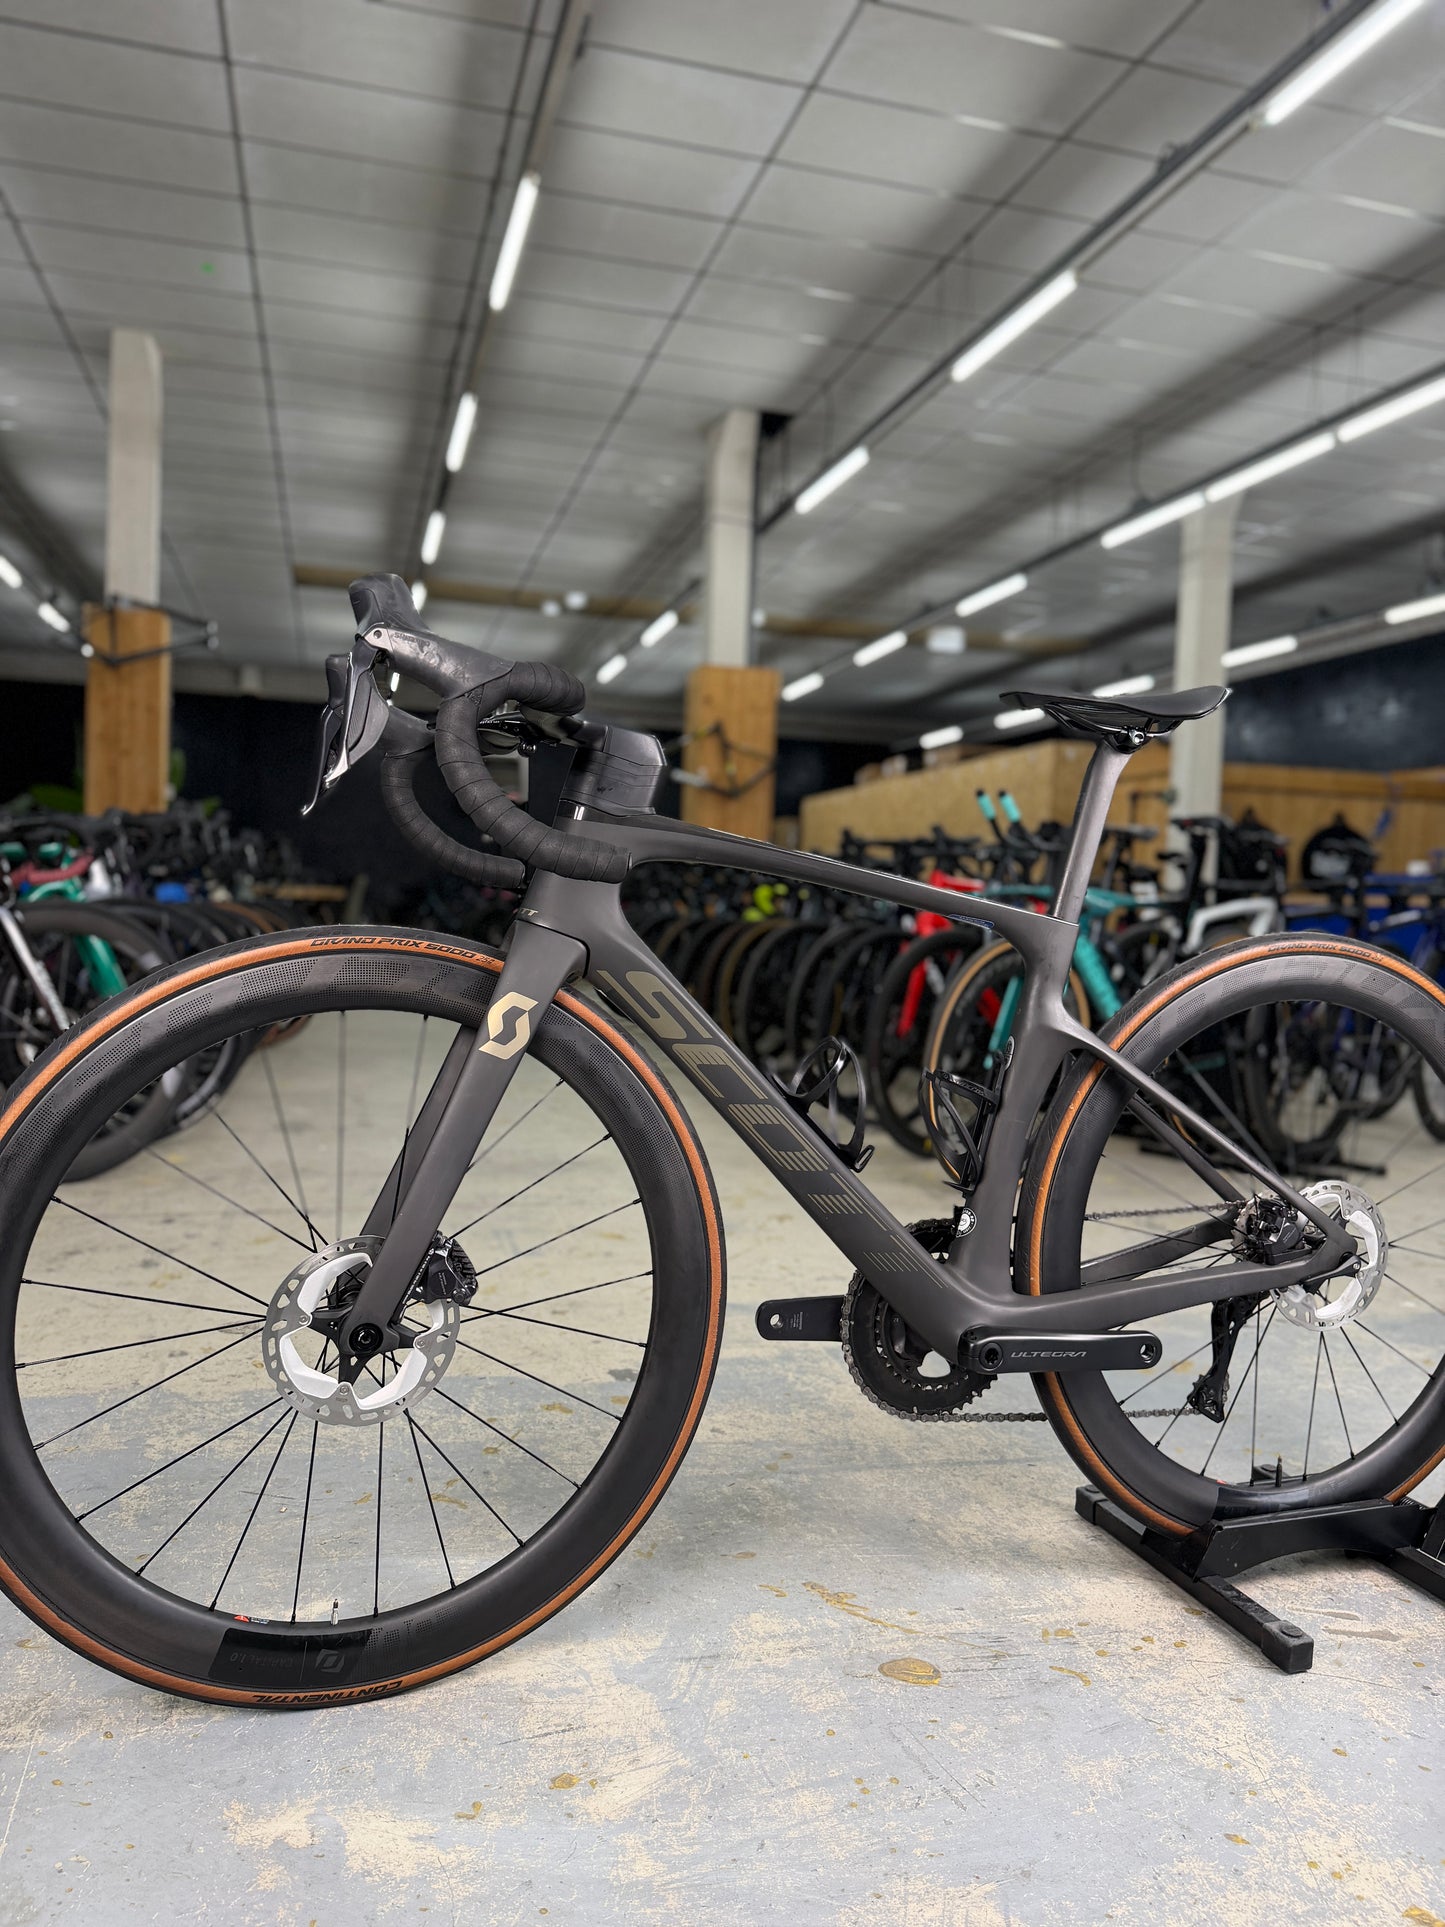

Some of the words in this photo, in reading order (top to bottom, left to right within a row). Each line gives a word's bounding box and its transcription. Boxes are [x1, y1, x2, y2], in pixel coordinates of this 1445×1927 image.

[310, 937, 377, 947] GRAND
[377, 937, 426, 948] PRIX
[424, 943, 477, 959] 5000
[1268, 943, 1309, 953] GRAND
[1309, 942, 1338, 951] PRIX
[596, 968, 950, 1289] SCOTT
[252, 1680, 403, 1703] CONTINENTAL
